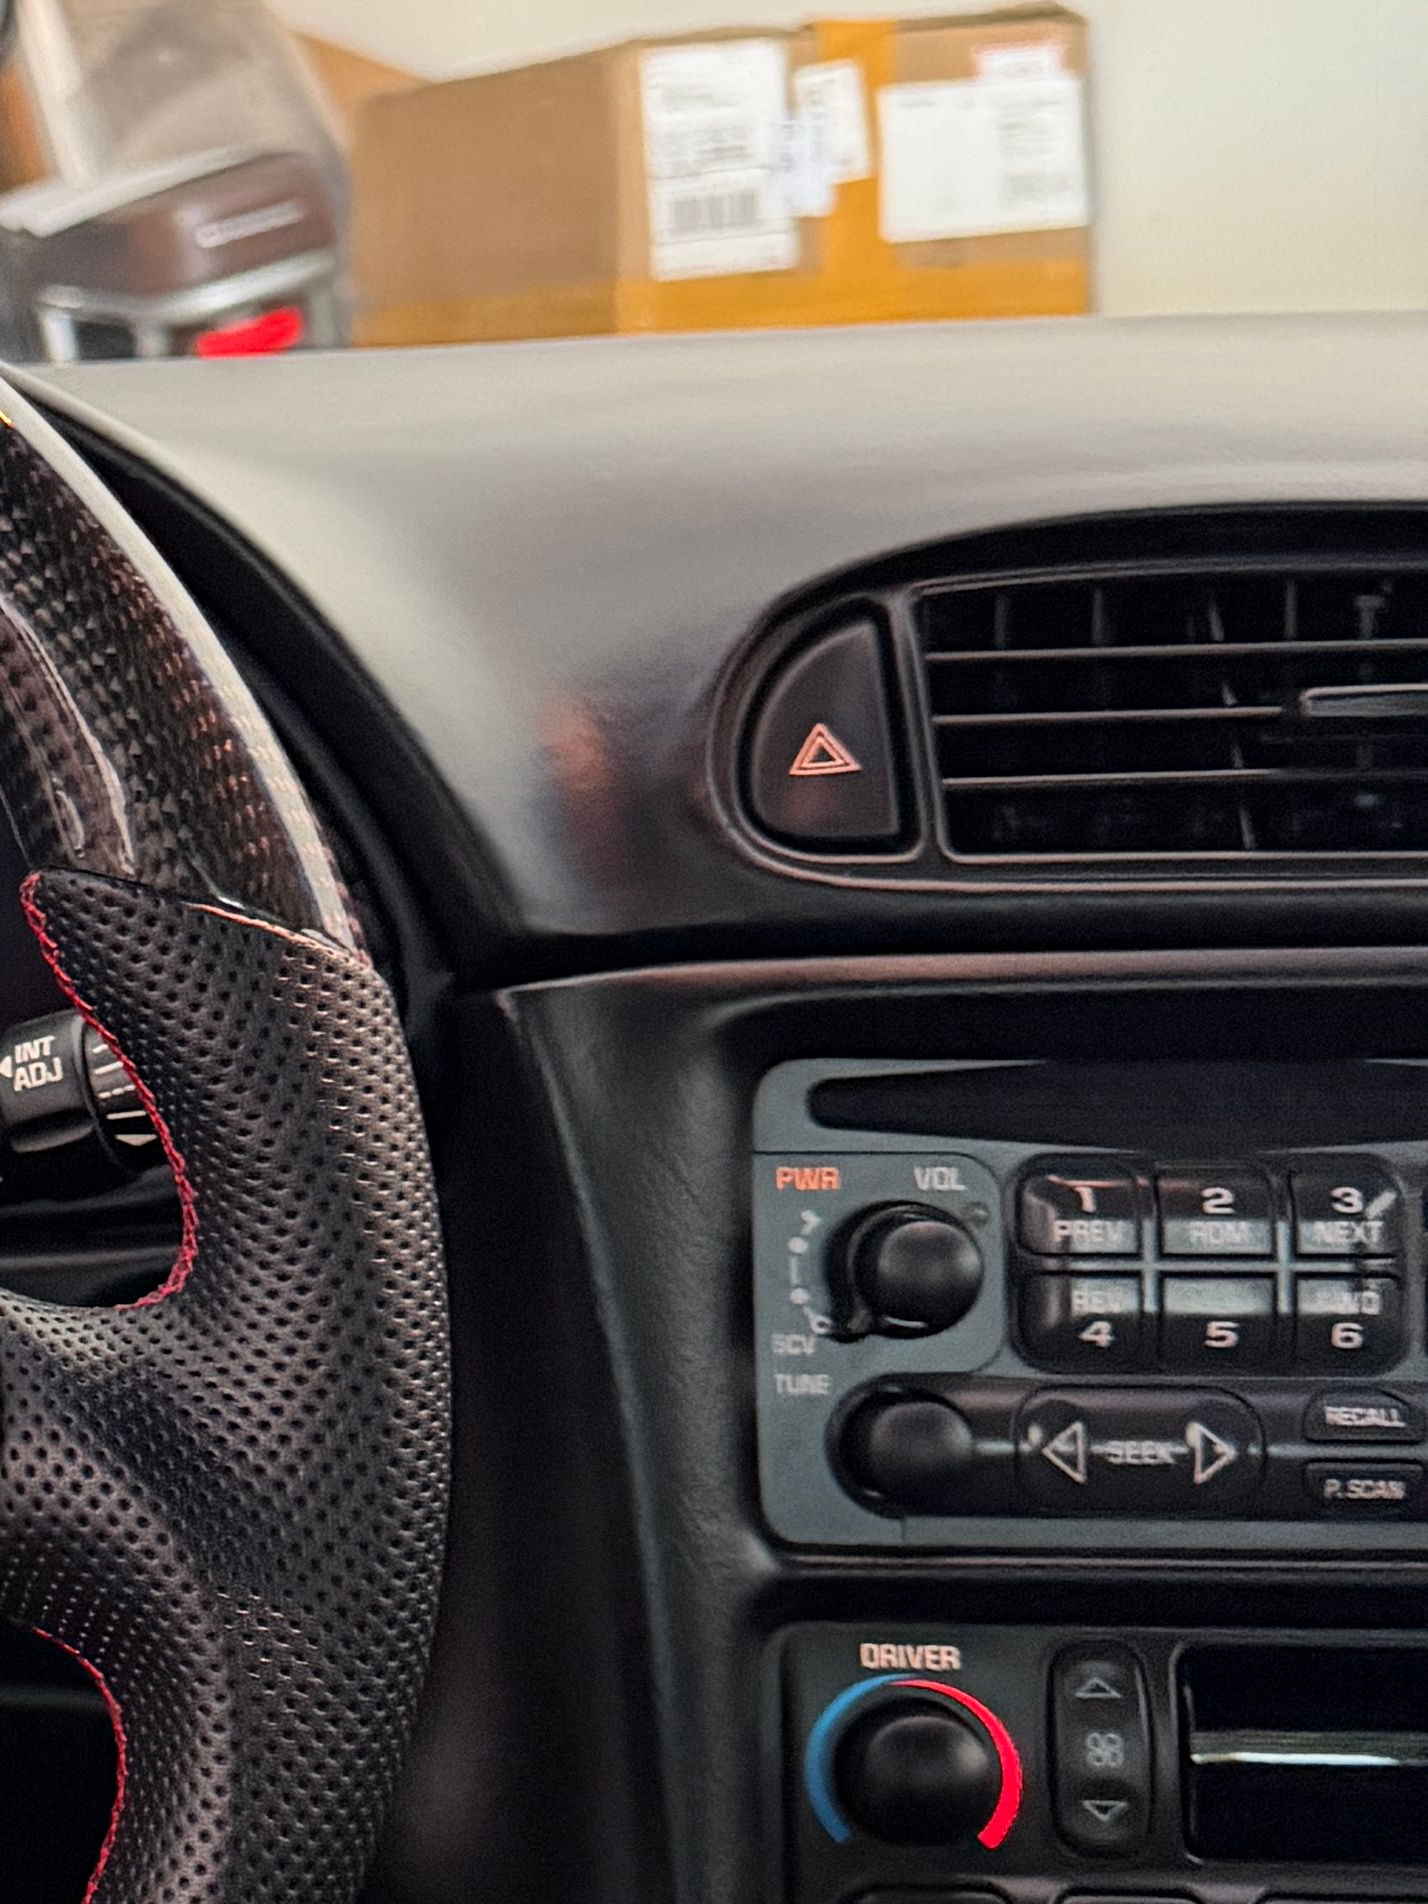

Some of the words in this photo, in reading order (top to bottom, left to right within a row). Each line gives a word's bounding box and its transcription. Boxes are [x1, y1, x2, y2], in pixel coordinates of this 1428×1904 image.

[14, 1035, 56, 1063] INT
[13, 1057, 63, 1092] ADJ
[775, 1166, 841, 1191] PWR
[914, 1167, 968, 1191] VOL
[1201, 1187, 1235, 1214] 2
[1331, 1187, 1364, 1214] 3
[1311, 1220, 1384, 1243] NEXT
[1078, 1320, 1114, 1348] 4
[1204, 1321, 1239, 1348] 5
[1330, 1322, 1364, 1349] 6
[774, 1374, 831, 1395] TUNE
[1324, 1406, 1406, 1428] RECALL
[860, 1643, 961, 1671] DRIVER
